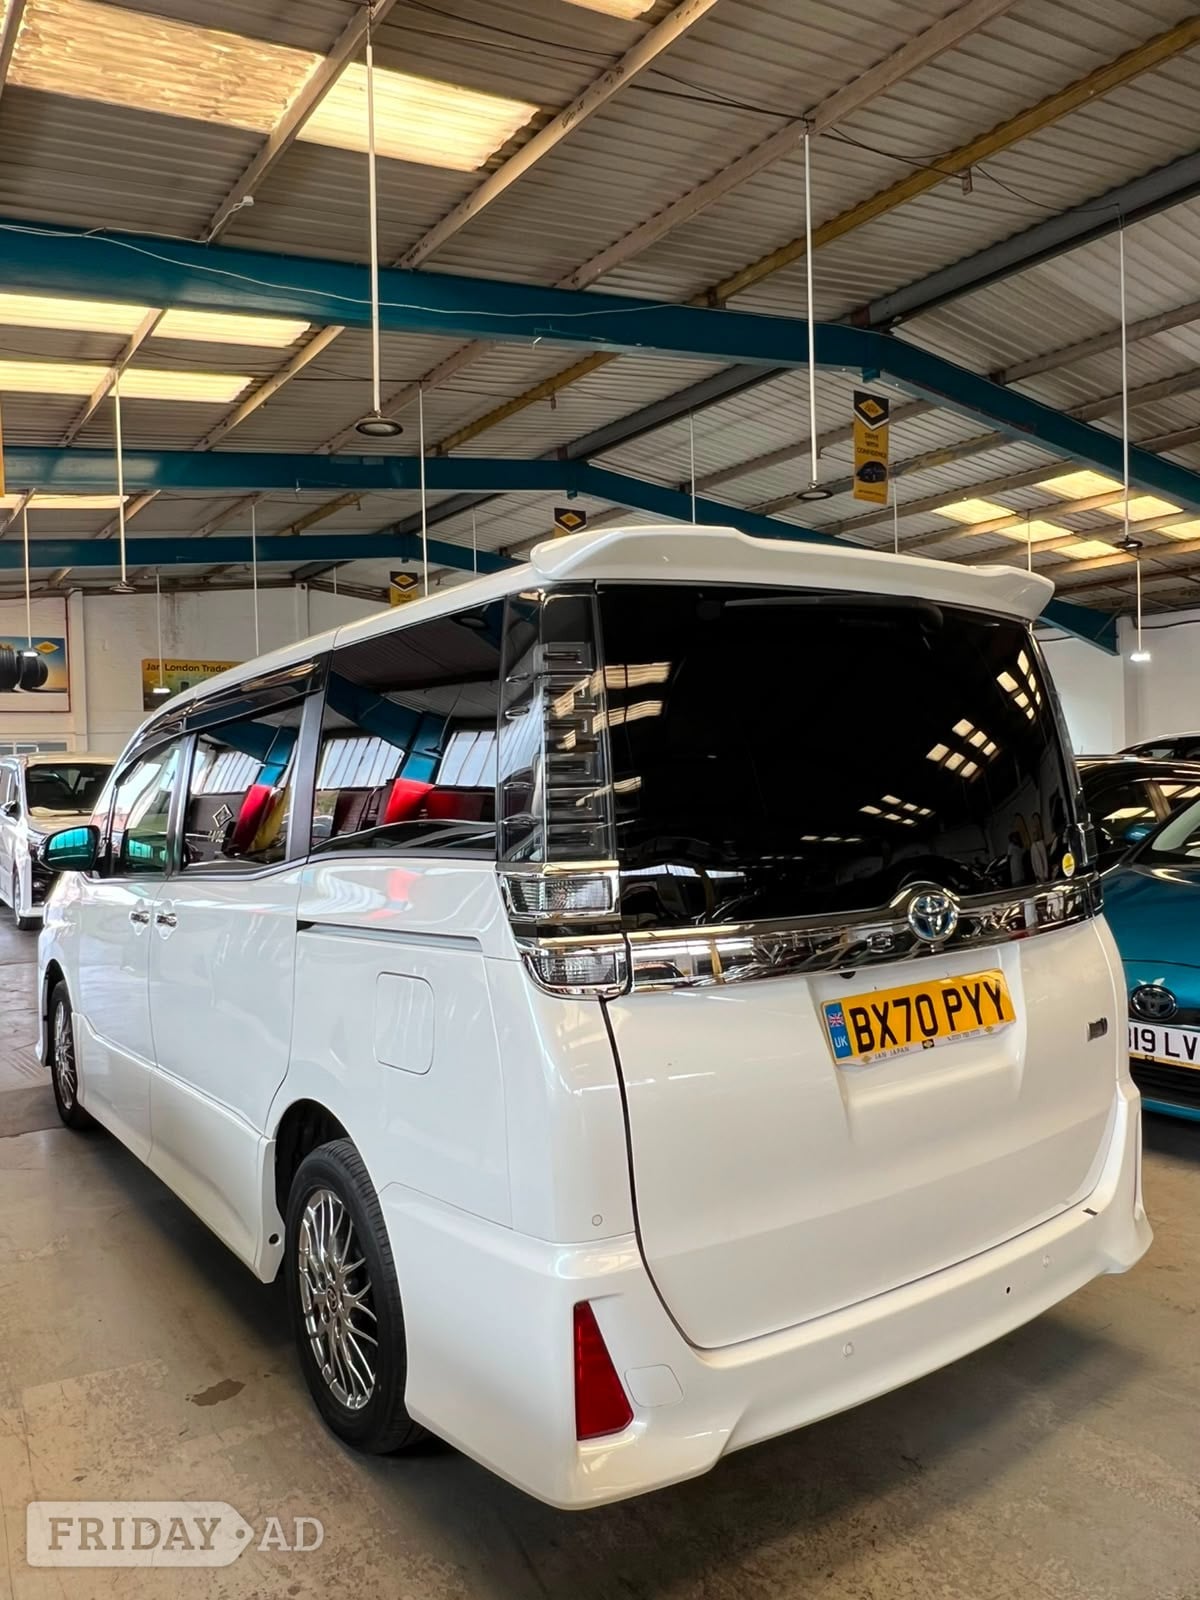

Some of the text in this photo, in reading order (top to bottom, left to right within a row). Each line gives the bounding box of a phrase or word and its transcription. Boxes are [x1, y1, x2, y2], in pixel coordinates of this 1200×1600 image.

[165, 663, 200, 672] London
[848, 979, 1005, 1054] BX70 PYY
[834, 1035, 848, 1049] UK
[1128, 1026, 1198, 1061] 19 LV
[889, 1046, 910, 1057] JAPAN
